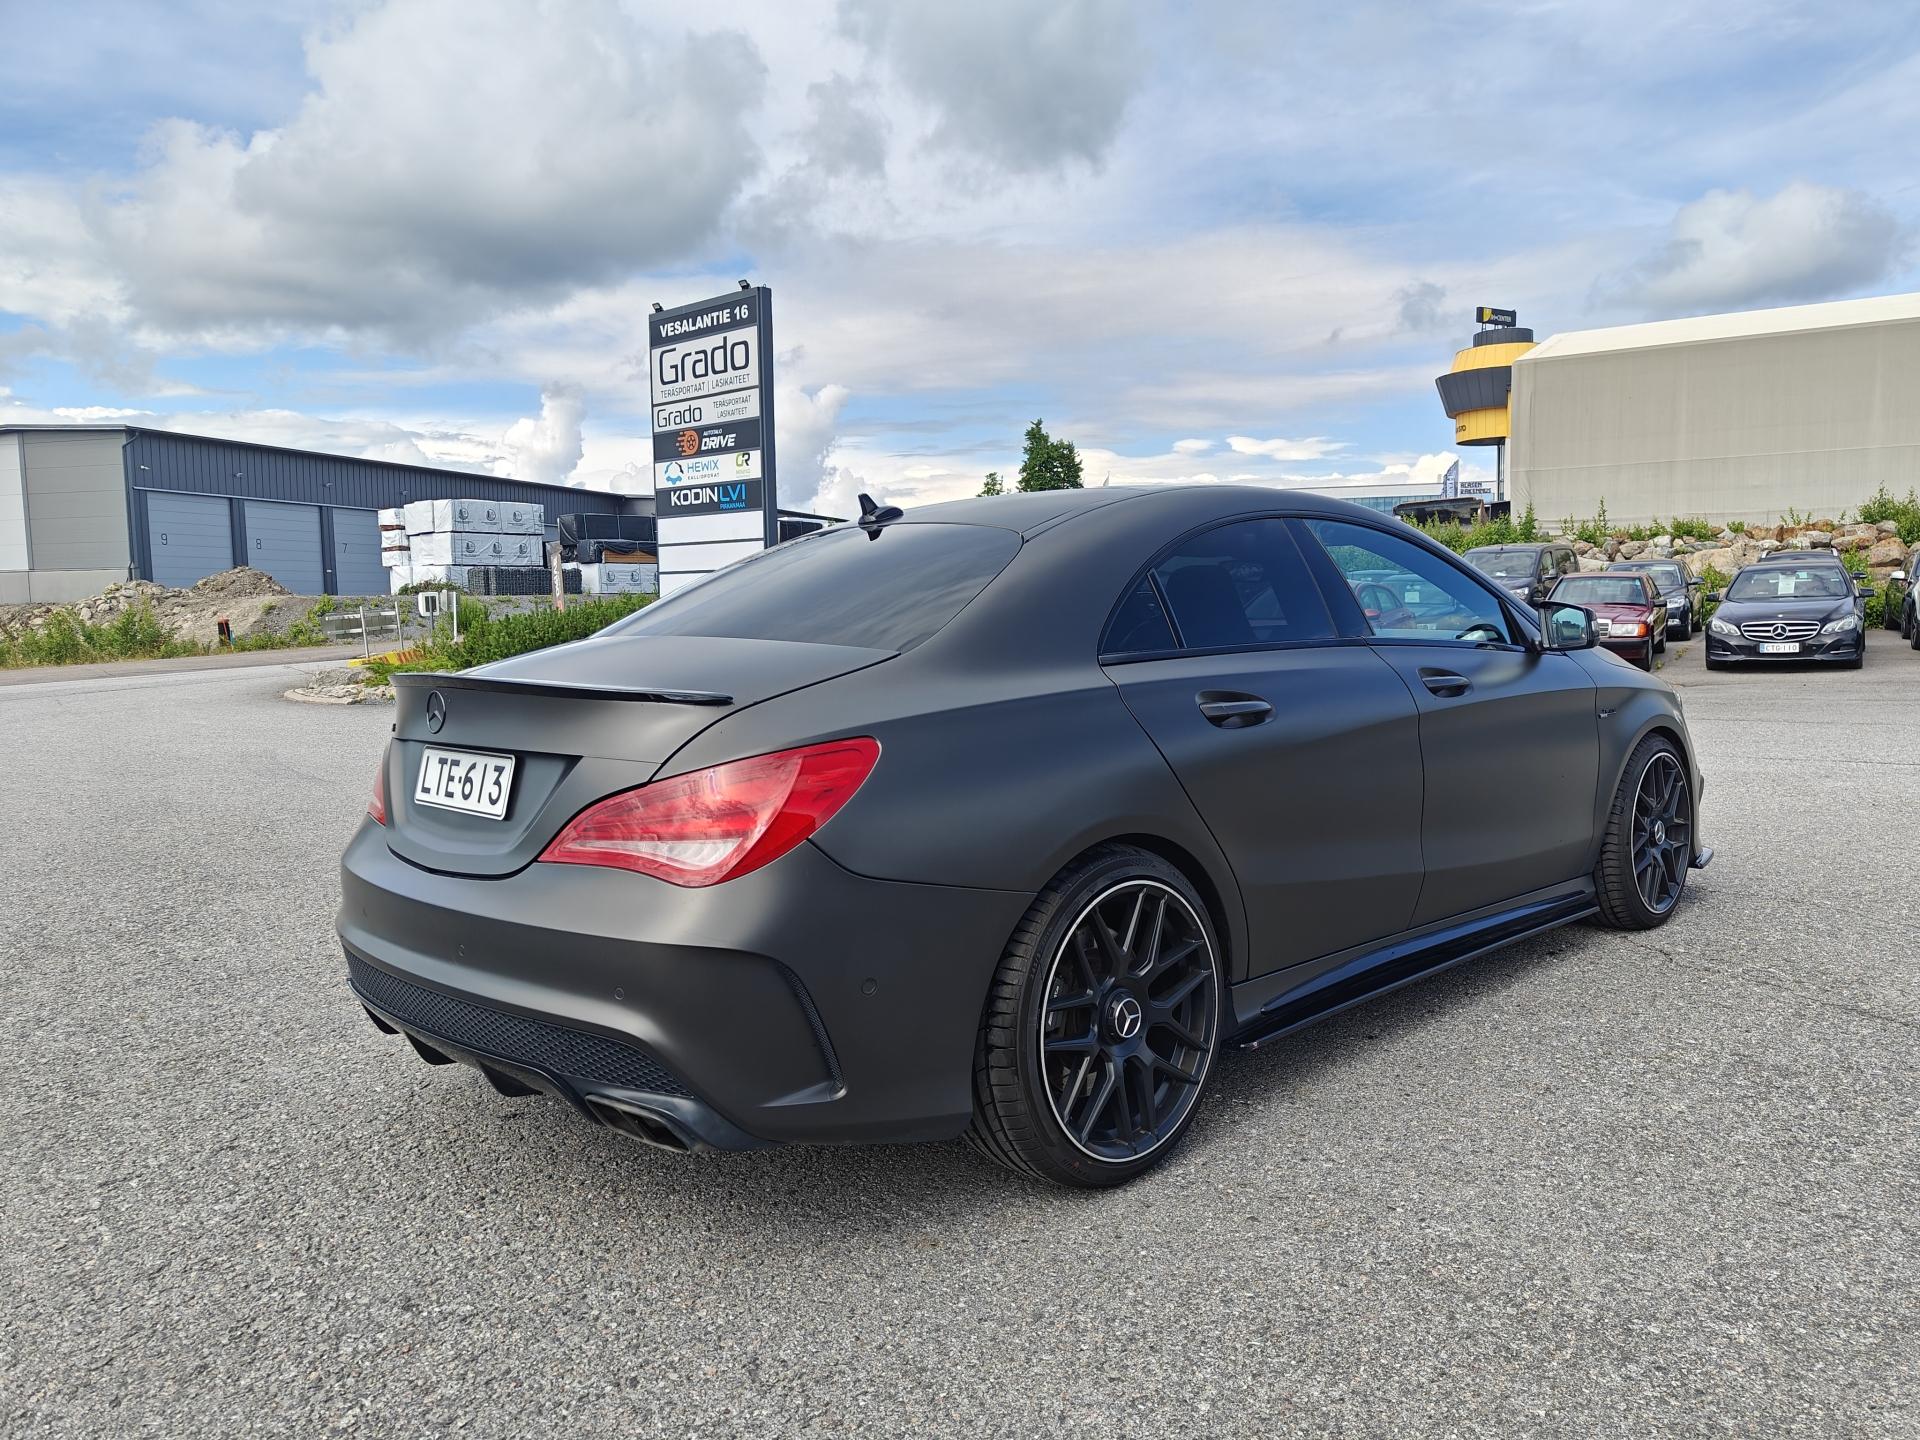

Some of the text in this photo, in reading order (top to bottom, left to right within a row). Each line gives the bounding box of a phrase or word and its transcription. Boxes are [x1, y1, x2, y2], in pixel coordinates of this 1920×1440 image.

[660, 304, 749, 338] VESALANTIE 16
[659, 336, 750, 385] Grado
[711, 373, 751, 390] LASIKAITEET
[657, 404, 703, 428] Grado
[701, 433, 737, 451] DRIVE
[687, 459, 720, 474] HEWIX
[160, 533, 168, 546] 9
[255, 538, 262, 550] 8
[341, 542, 348, 554] 7
[420, 755, 506, 806] LTE-613
